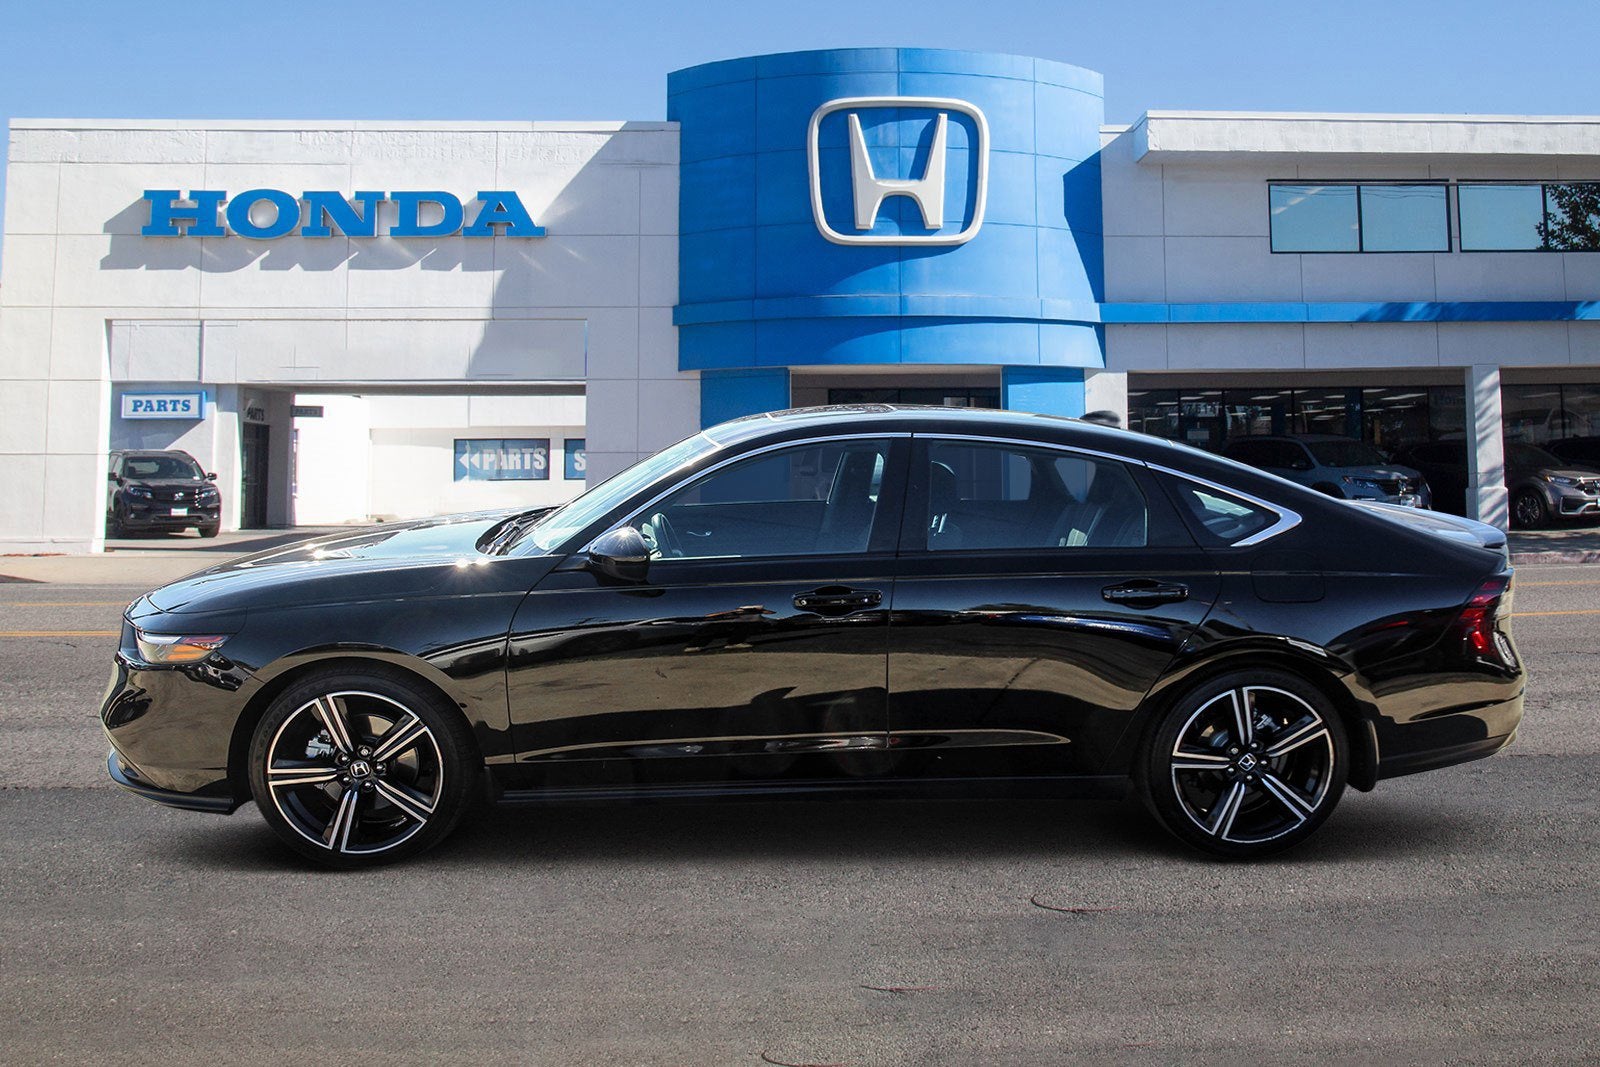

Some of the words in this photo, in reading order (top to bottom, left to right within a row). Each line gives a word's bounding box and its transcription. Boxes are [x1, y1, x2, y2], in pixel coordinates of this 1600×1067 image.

[142, 190, 546, 238] HONDA
[131, 400, 191, 412] PARTS
[483, 447, 547, 470] PARTS
